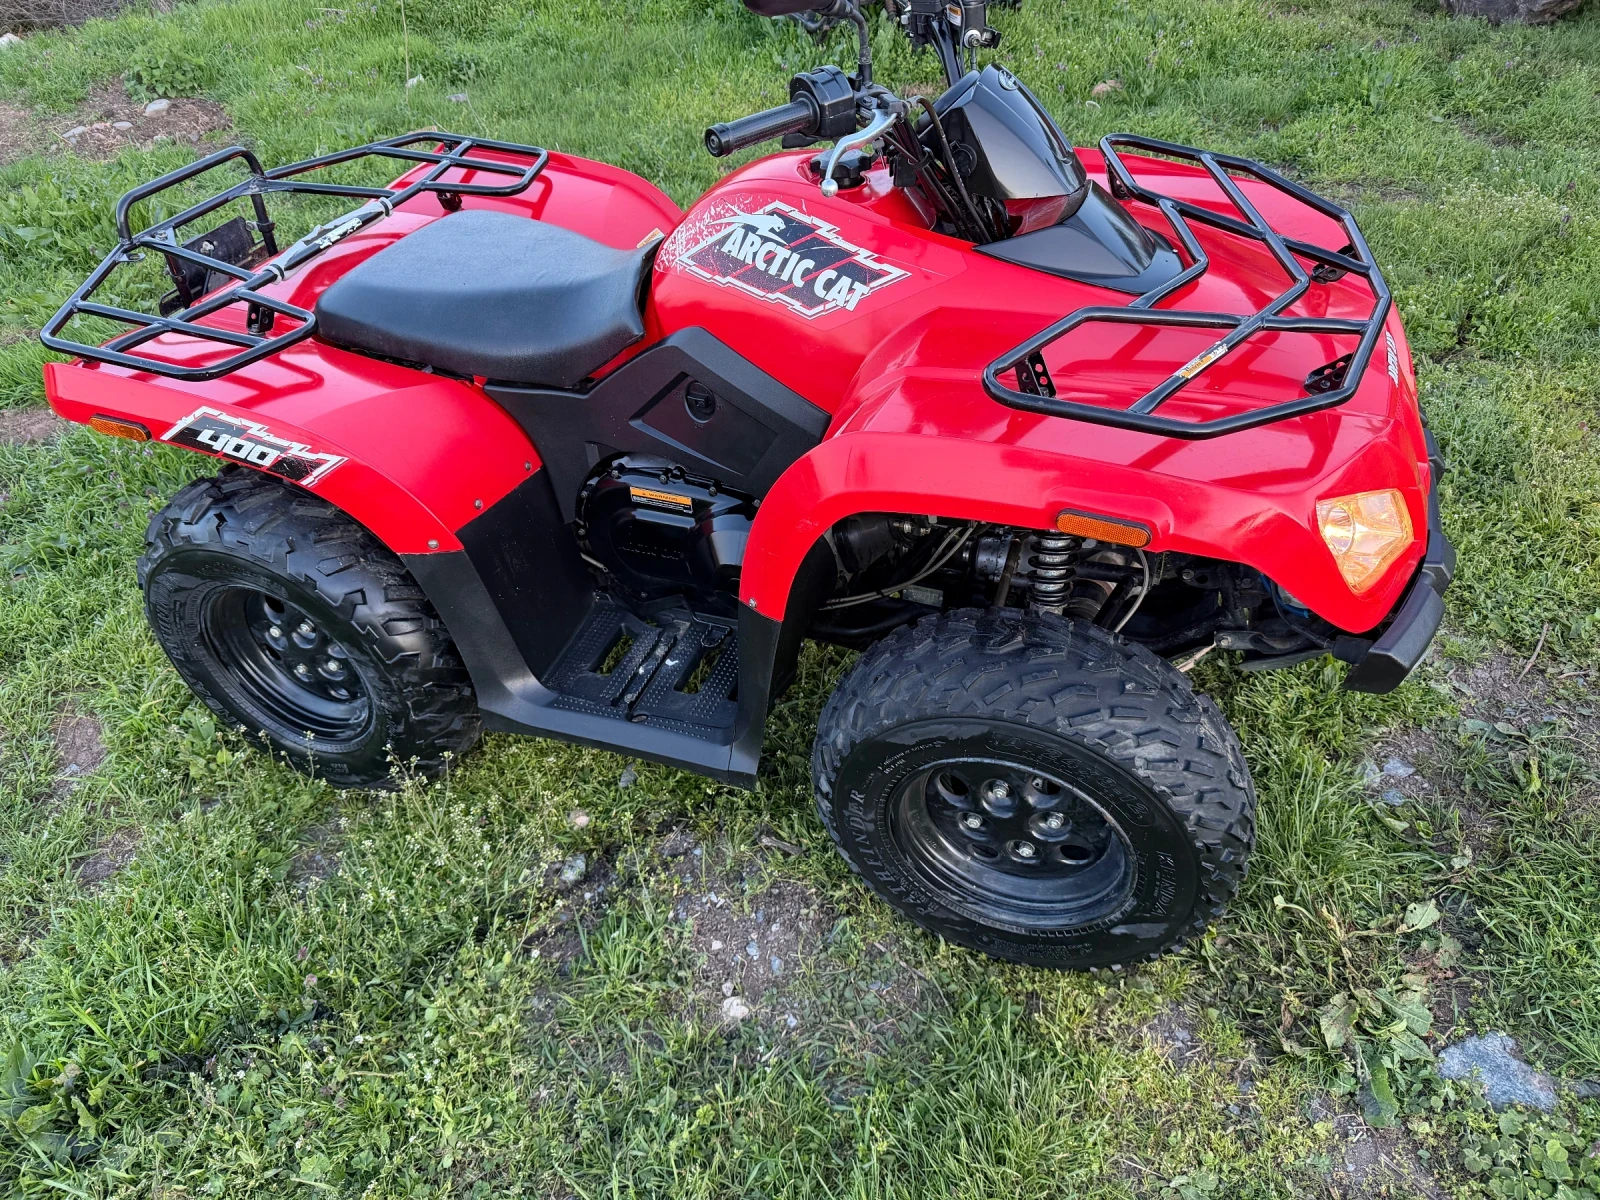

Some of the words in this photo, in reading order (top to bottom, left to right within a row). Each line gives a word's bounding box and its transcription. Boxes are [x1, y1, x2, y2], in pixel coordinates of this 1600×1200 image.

[721, 228, 816, 288] ARCTIC
[814, 269, 871, 311] CAT
[197, 429, 281, 467] 400
[847, 789, 935, 916] PATHFINDER
[1150, 850, 1176, 917] KENDA
